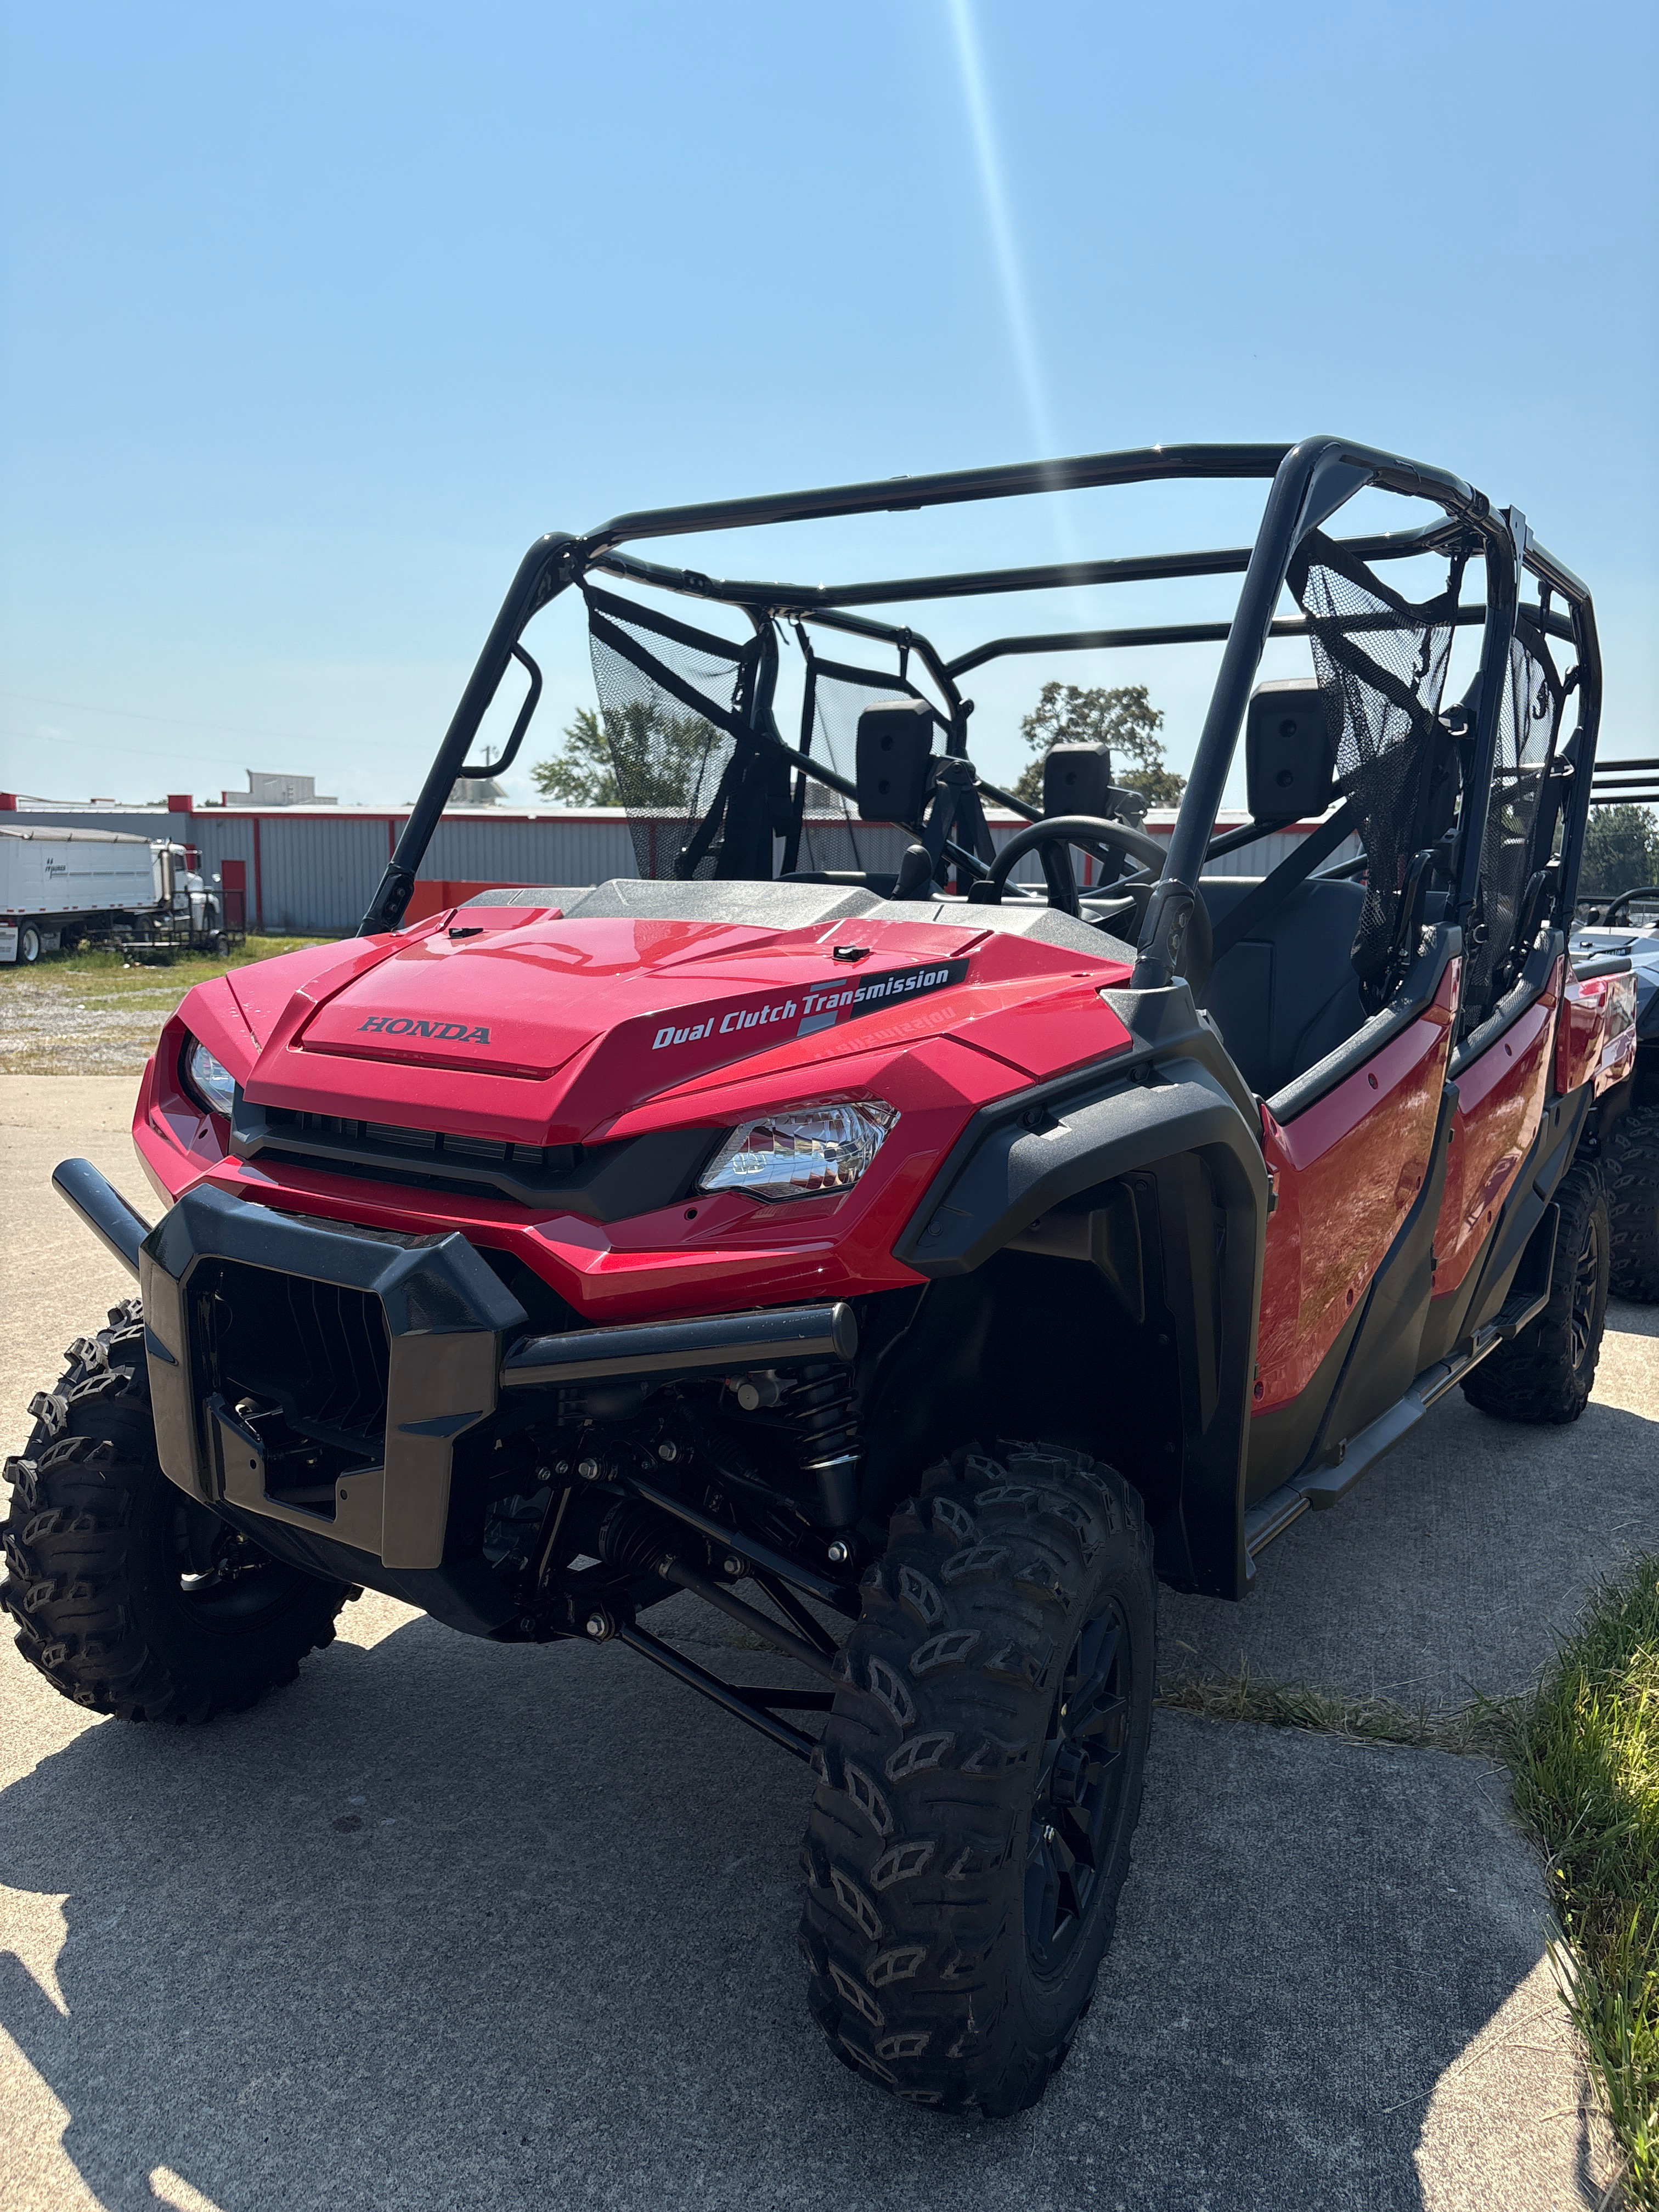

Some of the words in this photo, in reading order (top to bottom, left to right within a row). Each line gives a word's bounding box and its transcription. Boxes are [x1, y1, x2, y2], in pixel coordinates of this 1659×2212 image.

[357, 1016, 490, 1045] HONDA
[652, 1017, 715, 1050] Dual
[719, 1000, 797, 1034] Clutch
[802, 969, 949, 1015] Transmission
